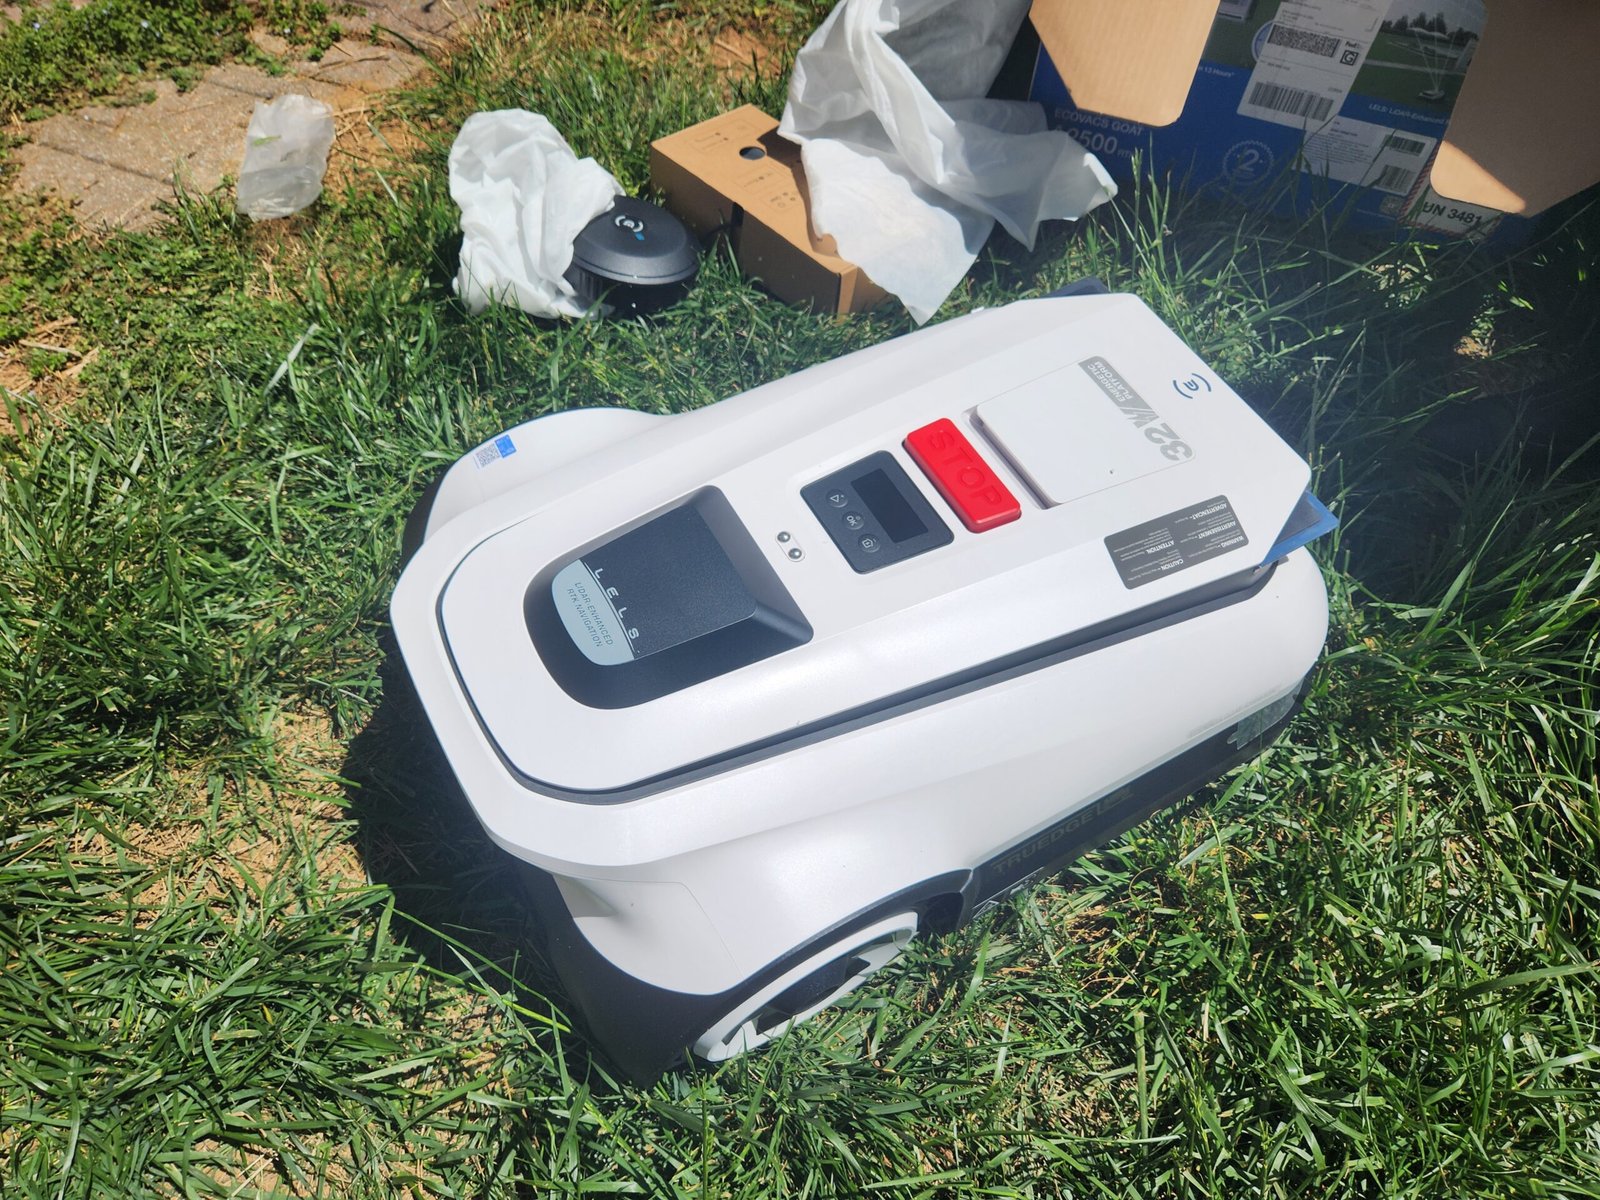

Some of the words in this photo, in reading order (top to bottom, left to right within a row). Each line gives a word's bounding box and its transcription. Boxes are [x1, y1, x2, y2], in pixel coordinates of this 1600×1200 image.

[1054, 107, 1109, 129] ECOVACS
[1111, 121, 1144, 136] GOAT
[1239, 149, 1259, 171] 2
[1422, 201, 1446, 216] UN
[1447, 208, 1483, 225] 3481
[1087, 363, 1126, 402] ENERGETIC
[1094, 361, 1133, 400] PLATFORM
[928, 430, 1002, 505] STOP
[846, 515, 857, 527] OK
[1146, 540, 1175, 554] ATTENTION
[1221, 535, 1244, 548] WARNING
[1160, 558, 1183, 571] CAUTION
[566, 588, 578, 604] RTK
[576, 603, 603, 647] NAVIGATION
